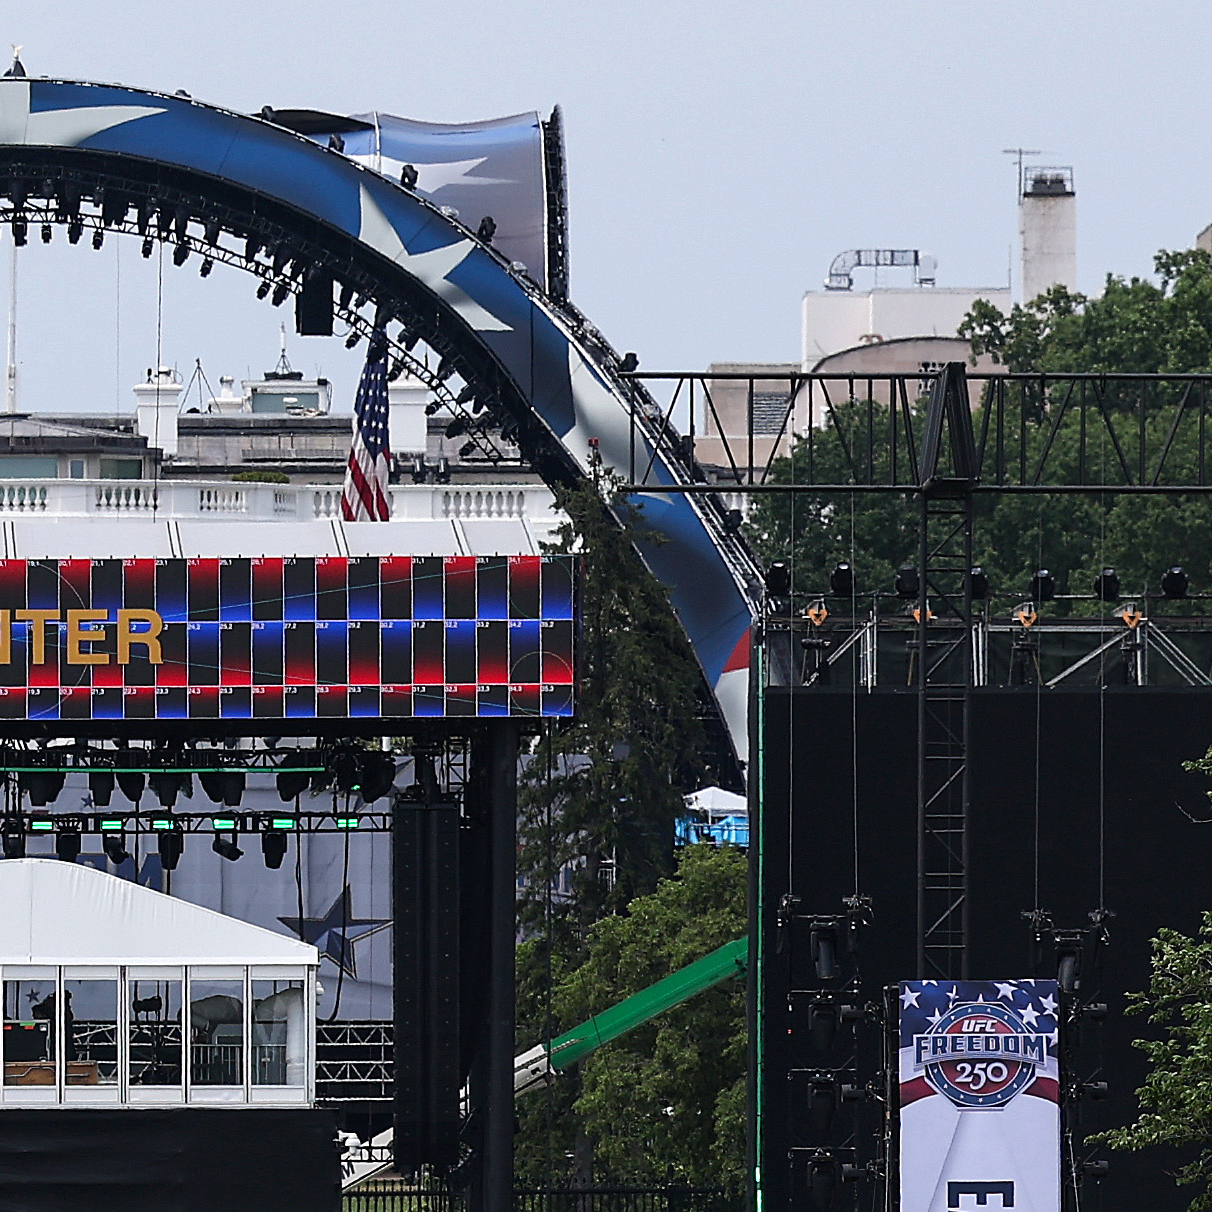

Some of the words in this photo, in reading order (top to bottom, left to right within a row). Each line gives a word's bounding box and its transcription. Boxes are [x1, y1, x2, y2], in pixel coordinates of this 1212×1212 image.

[961, 1019, 998, 1032] UFC
[915, 1035, 1046, 1065] FREEDOM
[955, 1062, 1008, 1090] 250
